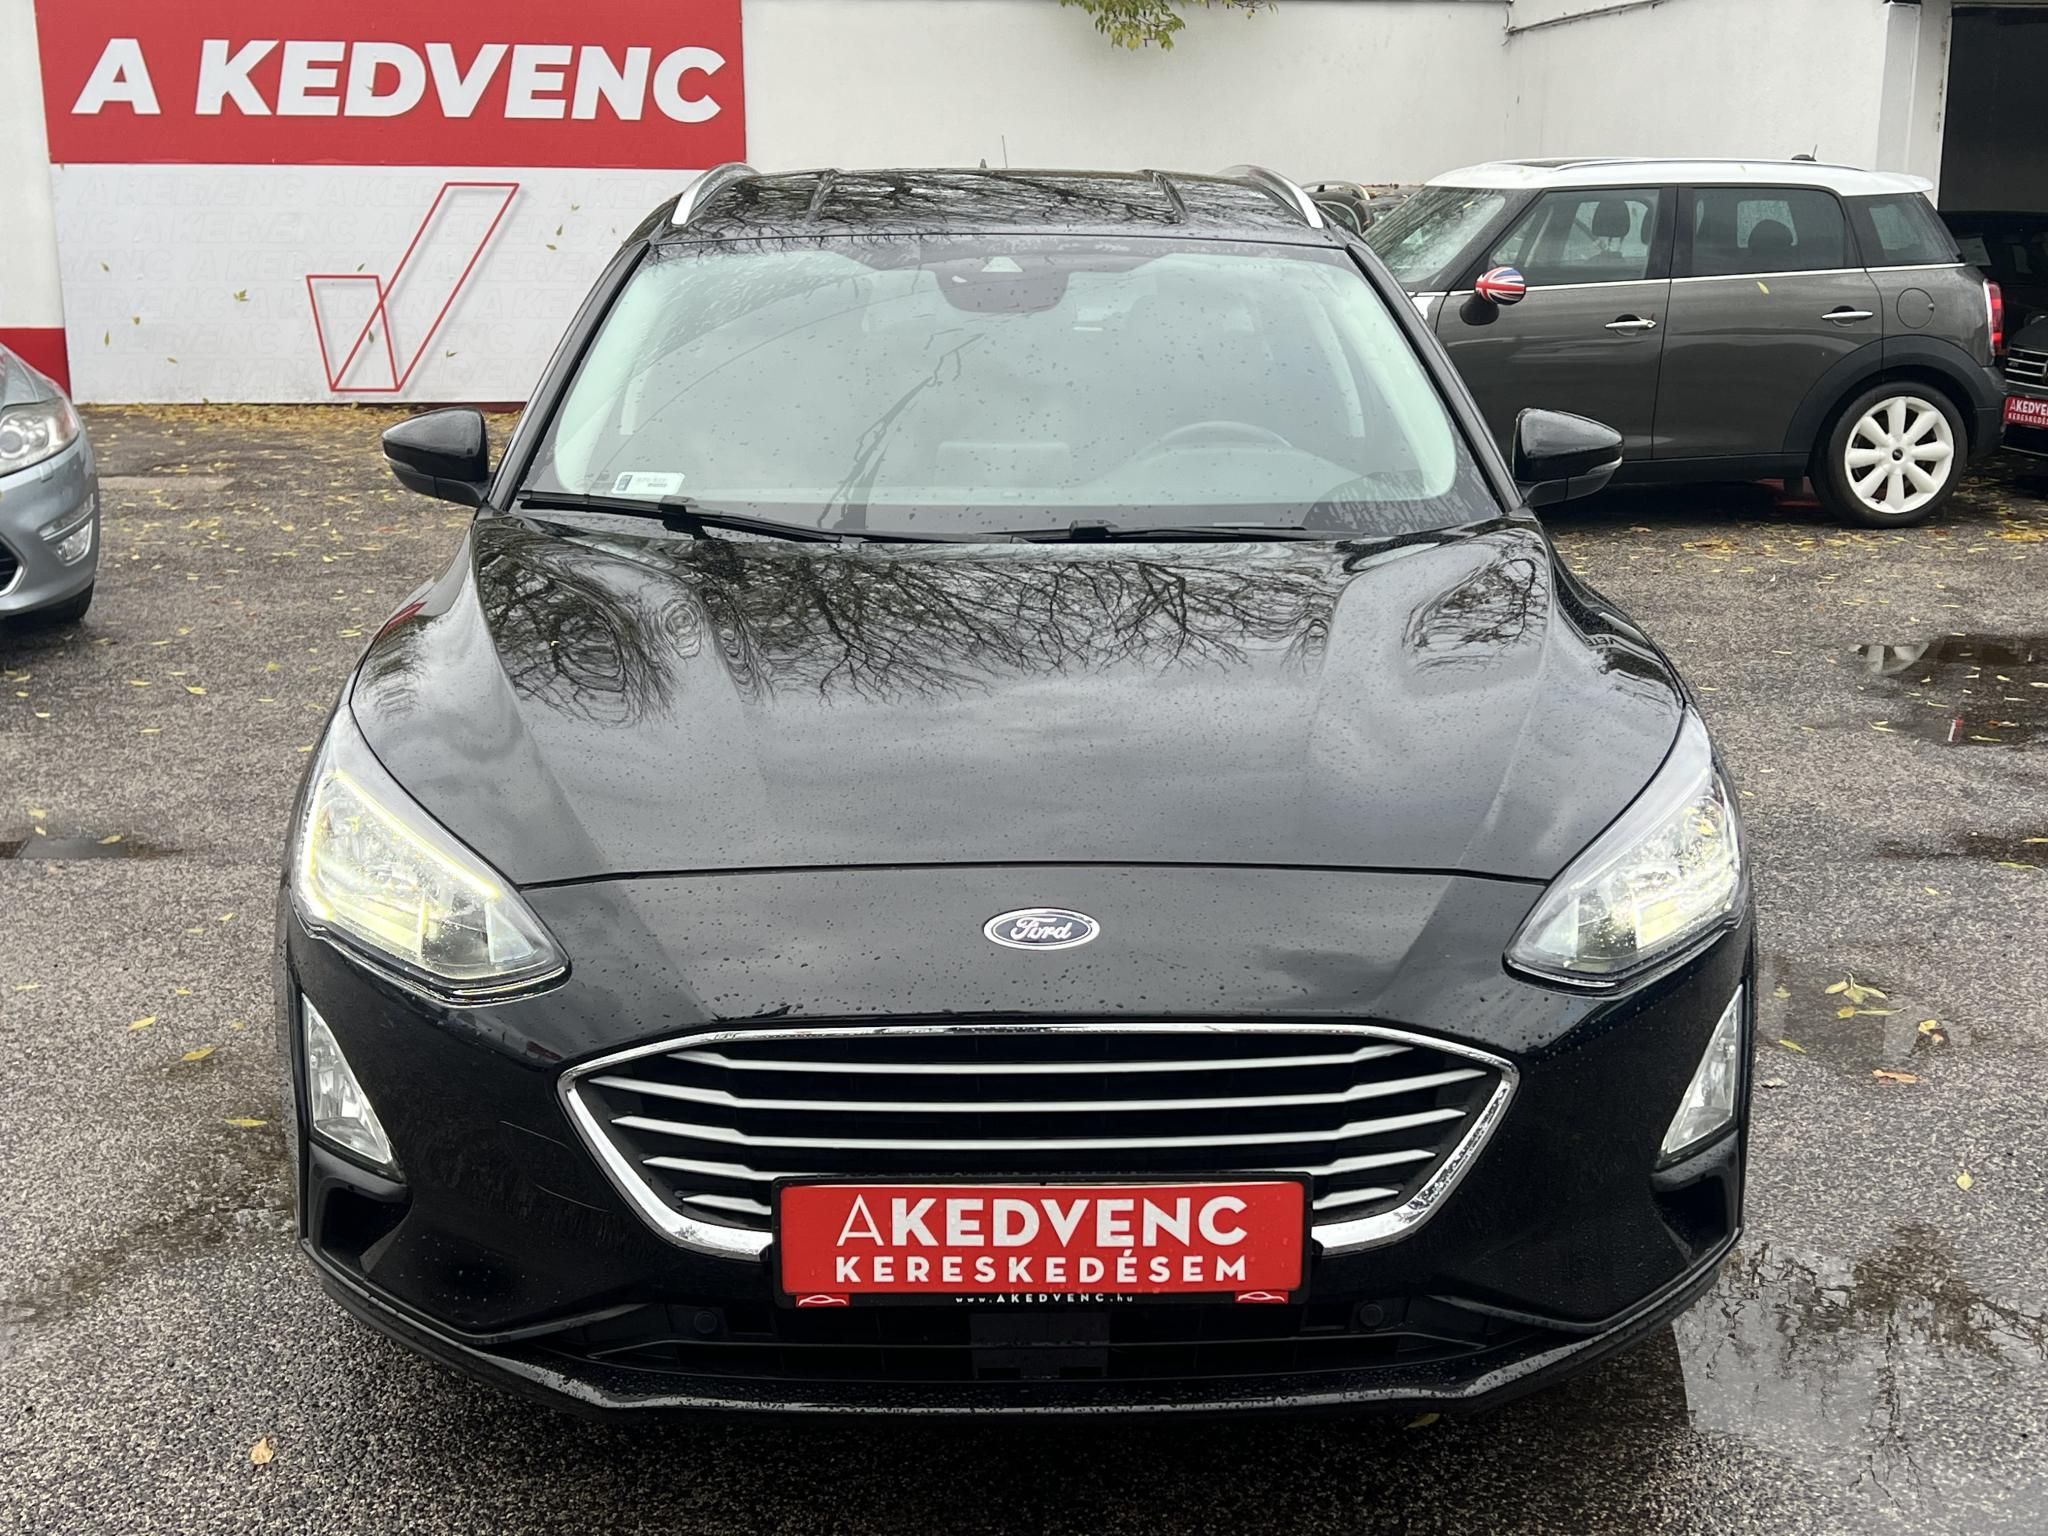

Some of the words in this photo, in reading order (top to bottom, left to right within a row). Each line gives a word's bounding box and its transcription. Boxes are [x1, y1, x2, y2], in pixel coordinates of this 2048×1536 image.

[71, 38, 161, 115] A
[195, 39, 727, 123] KEDVENC
[1009, 917, 1073, 940] Ford
[836, 1248, 1246, 1283] KERESKEDÉSEM
